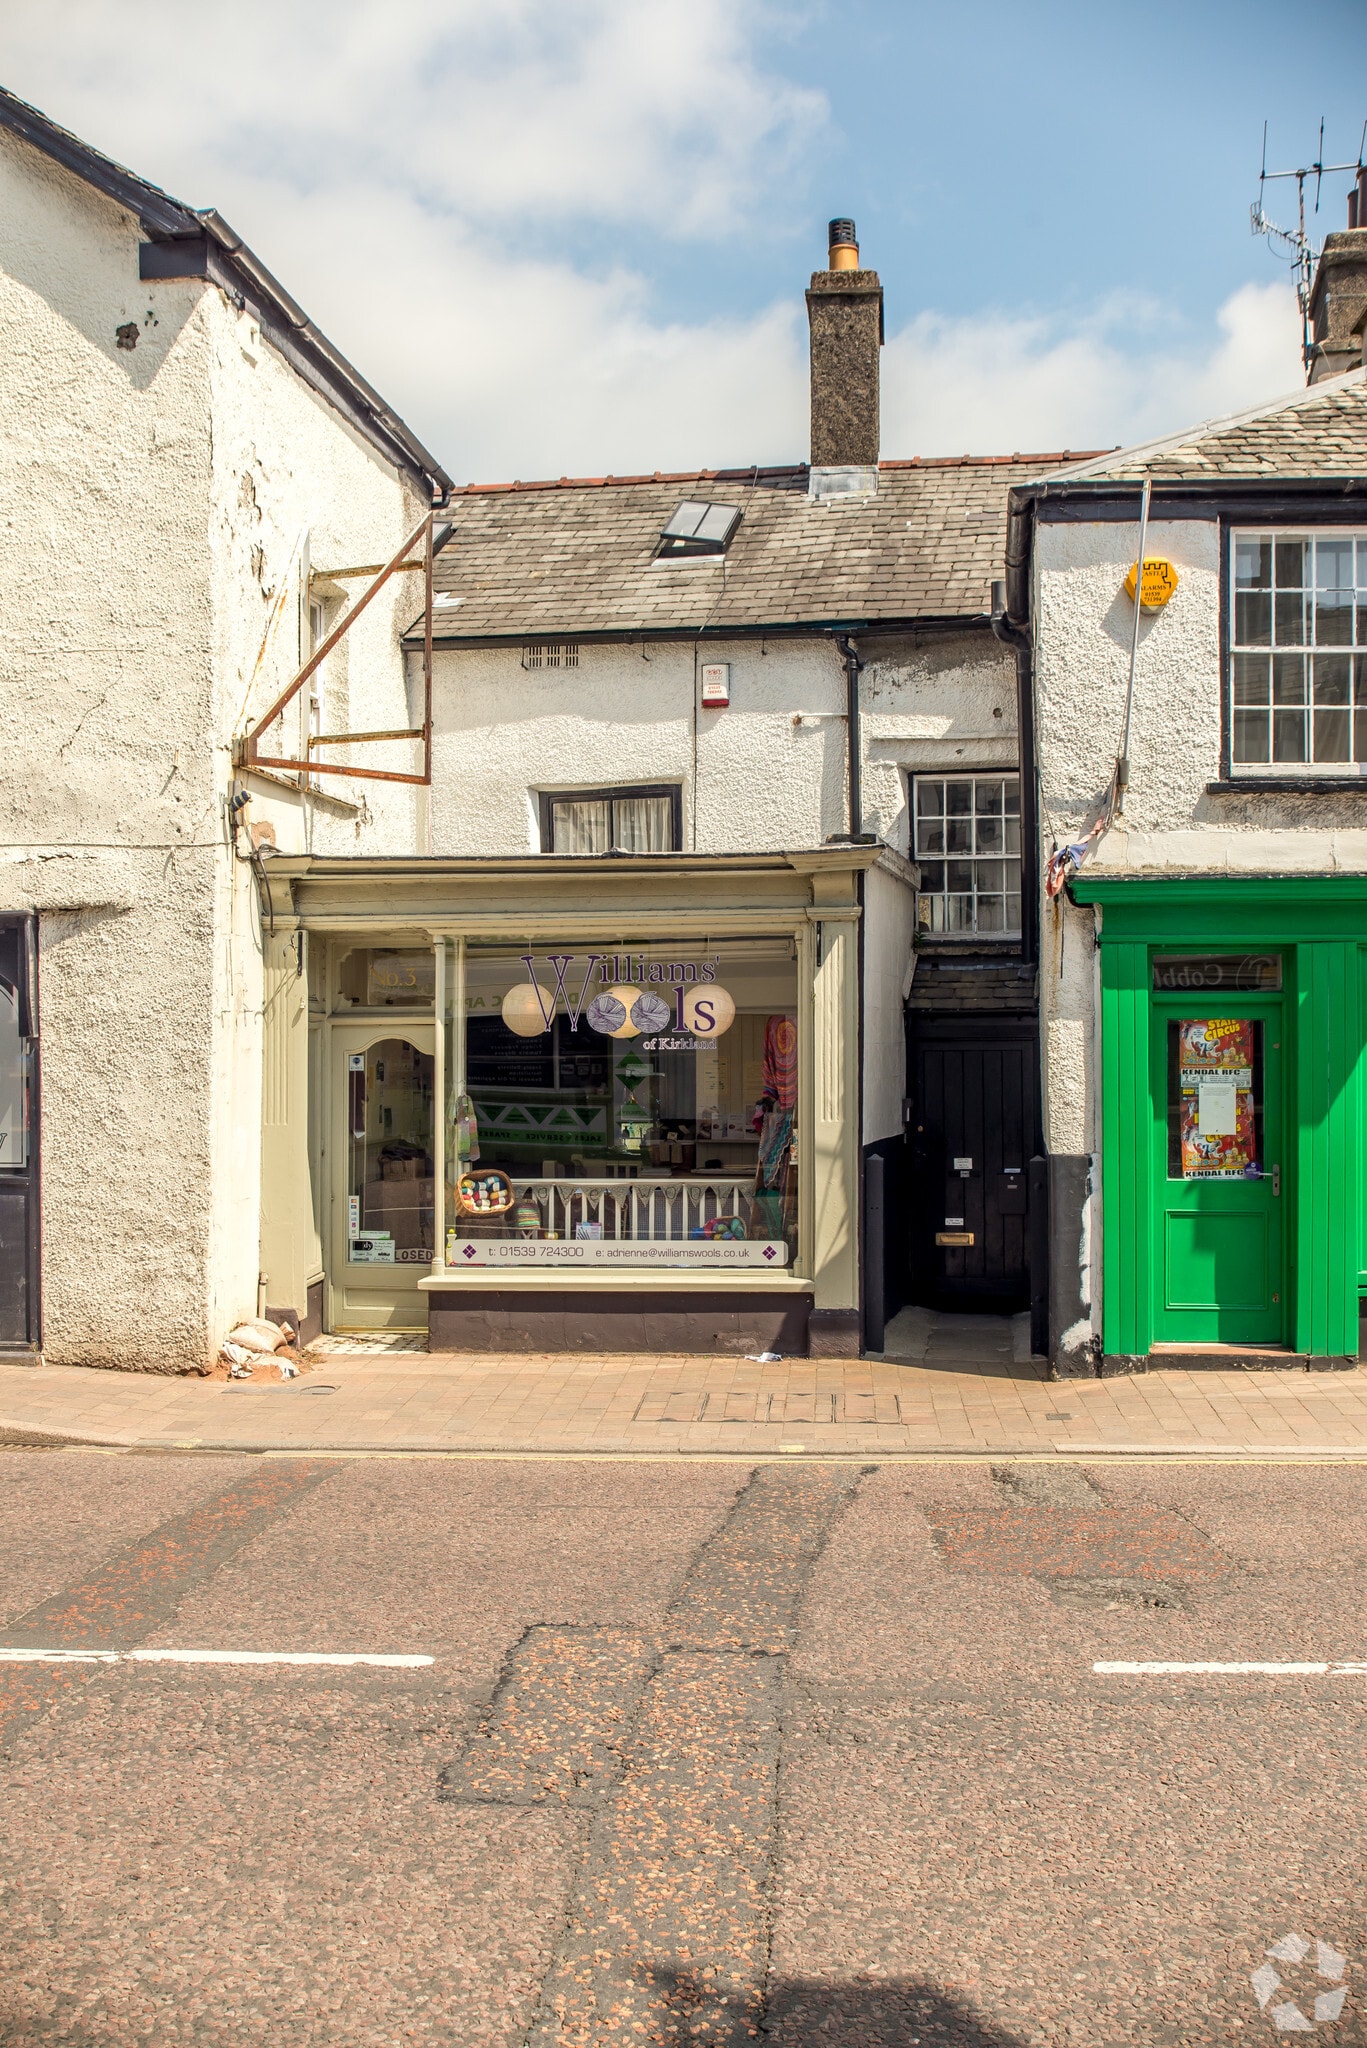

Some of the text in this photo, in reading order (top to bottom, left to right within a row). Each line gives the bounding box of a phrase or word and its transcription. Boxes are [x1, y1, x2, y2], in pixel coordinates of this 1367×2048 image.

[370, 967, 417, 987] No.3
[1204, 1023, 1241, 1042] CIRCUS
[643, 1038, 717, 1049] of Kirkland
[395, 1250, 433, 1260] LOSED
[488, 1246, 750, 1258] t: 01539 724300 e: adrienne@williamswools.co.uk
